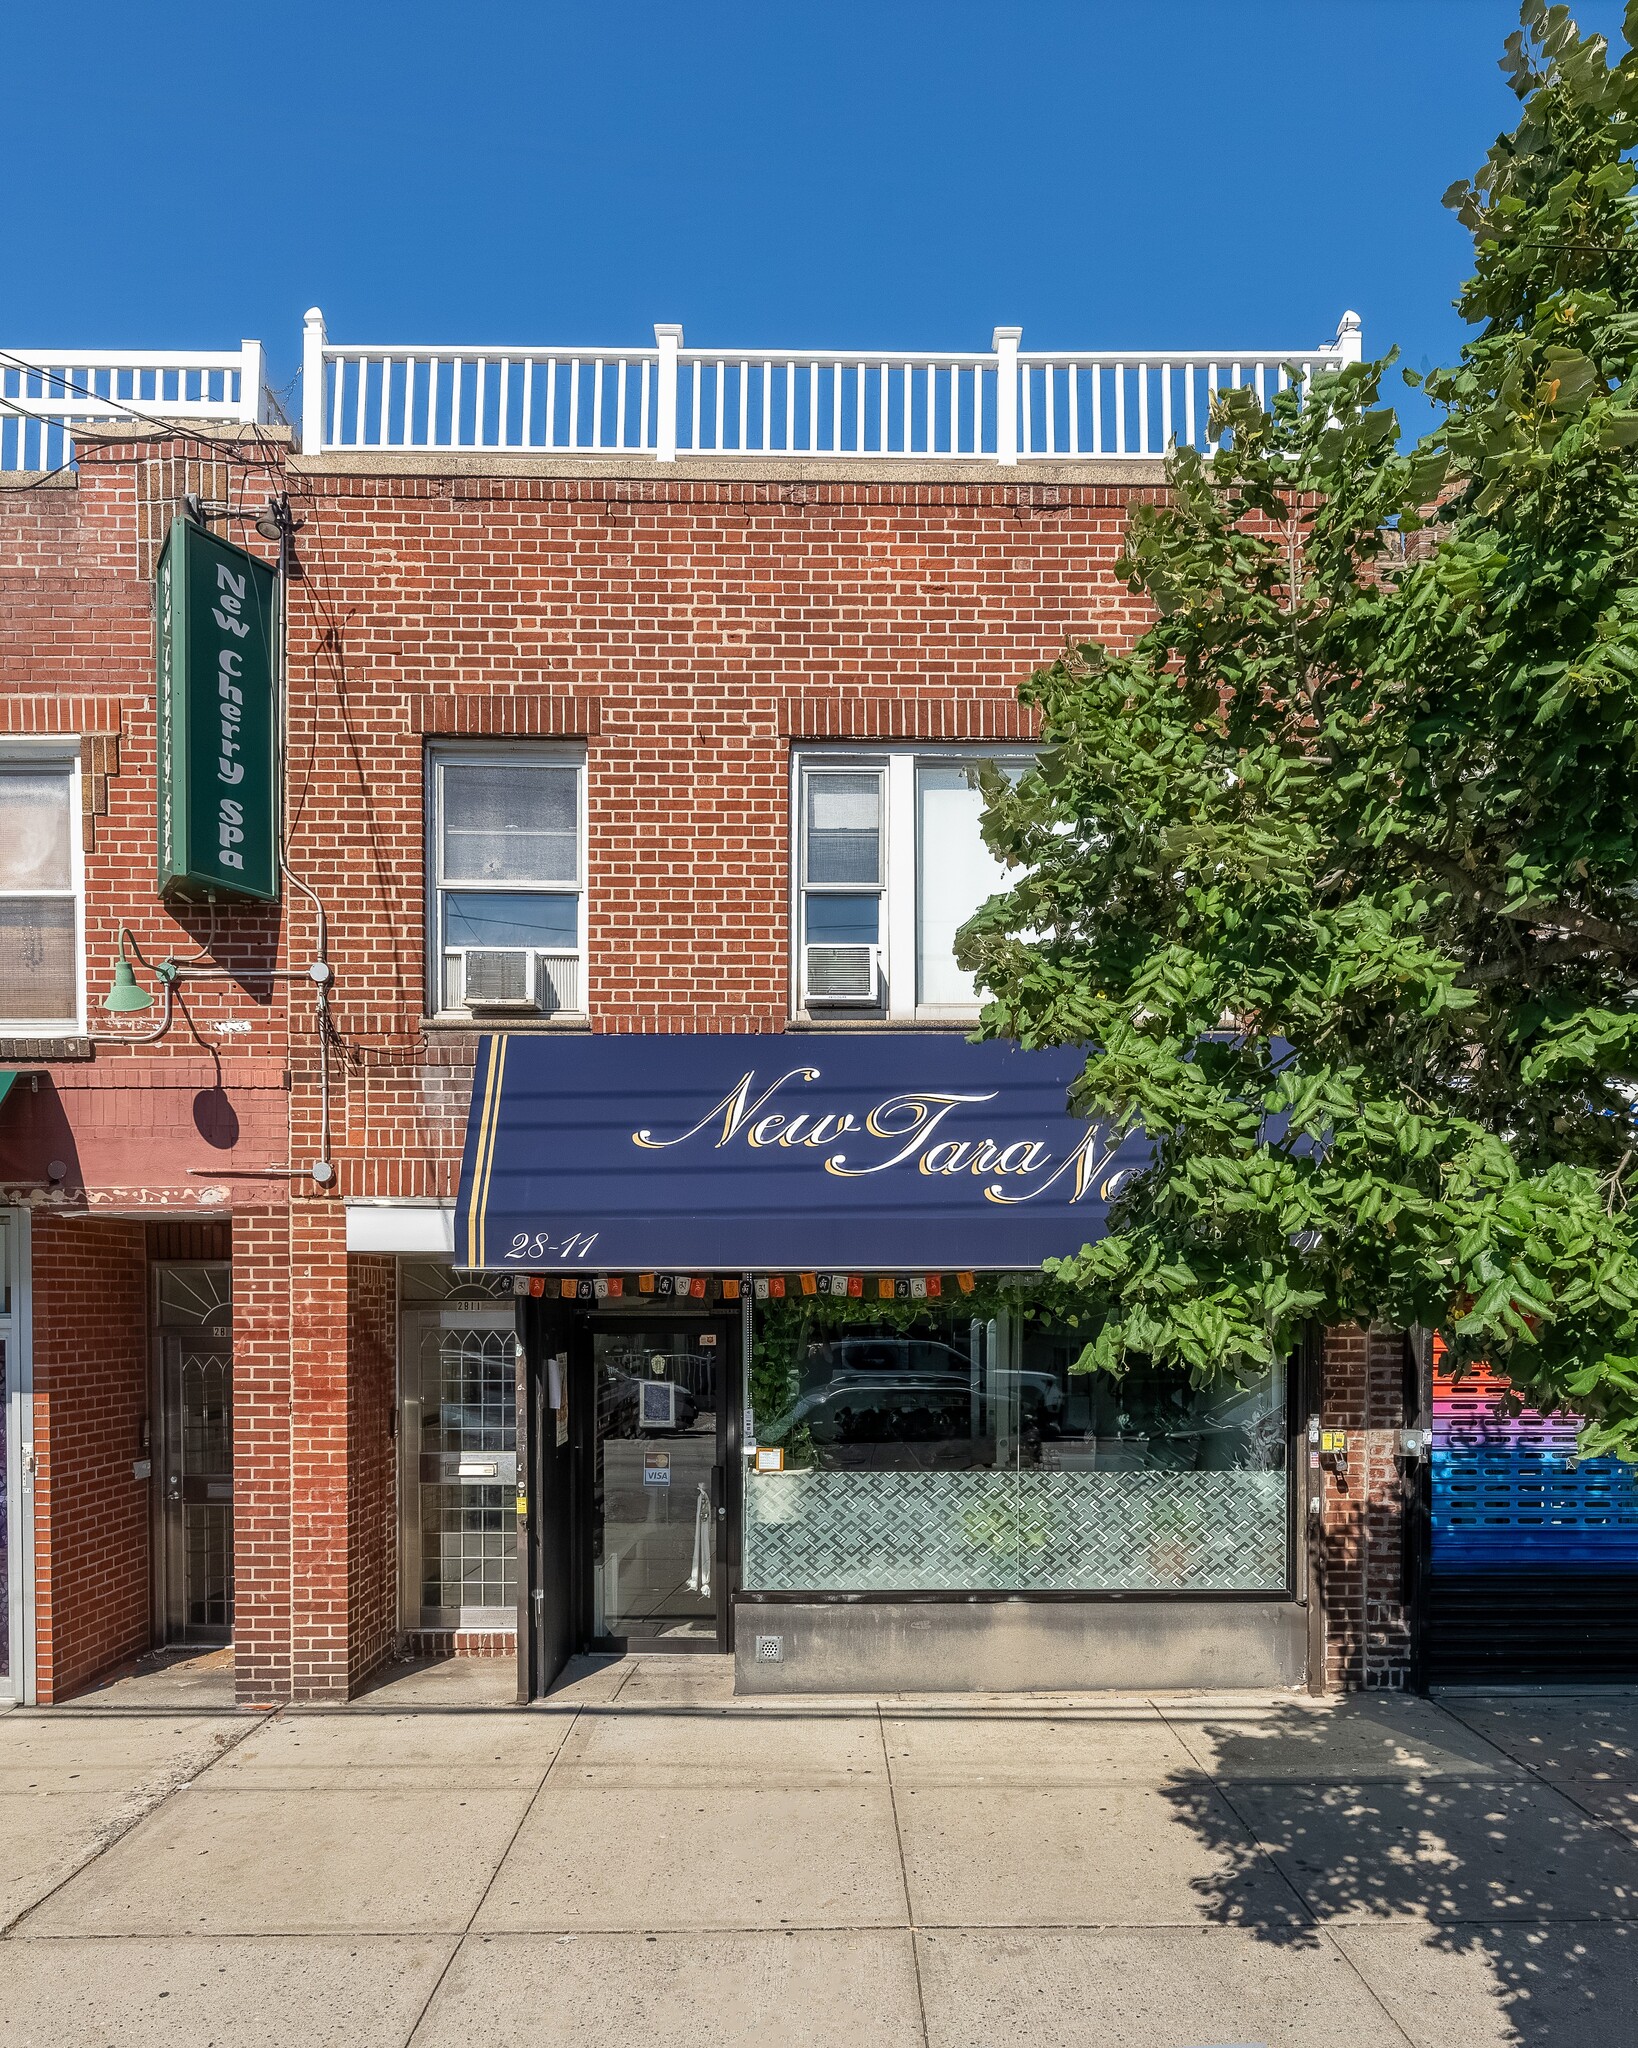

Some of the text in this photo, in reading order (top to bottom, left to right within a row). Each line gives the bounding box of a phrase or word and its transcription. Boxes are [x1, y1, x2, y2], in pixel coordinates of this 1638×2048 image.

[212, 563, 250, 870] New Cherry Spa
[631, 1067, 860, 1149] New
[824, 1091, 1048, 1178] Tara
[504, 1232, 600, 1260] 28-11
[457, 1301, 480, 1310] 2811
[648, 1471, 668, 1480] VISA
